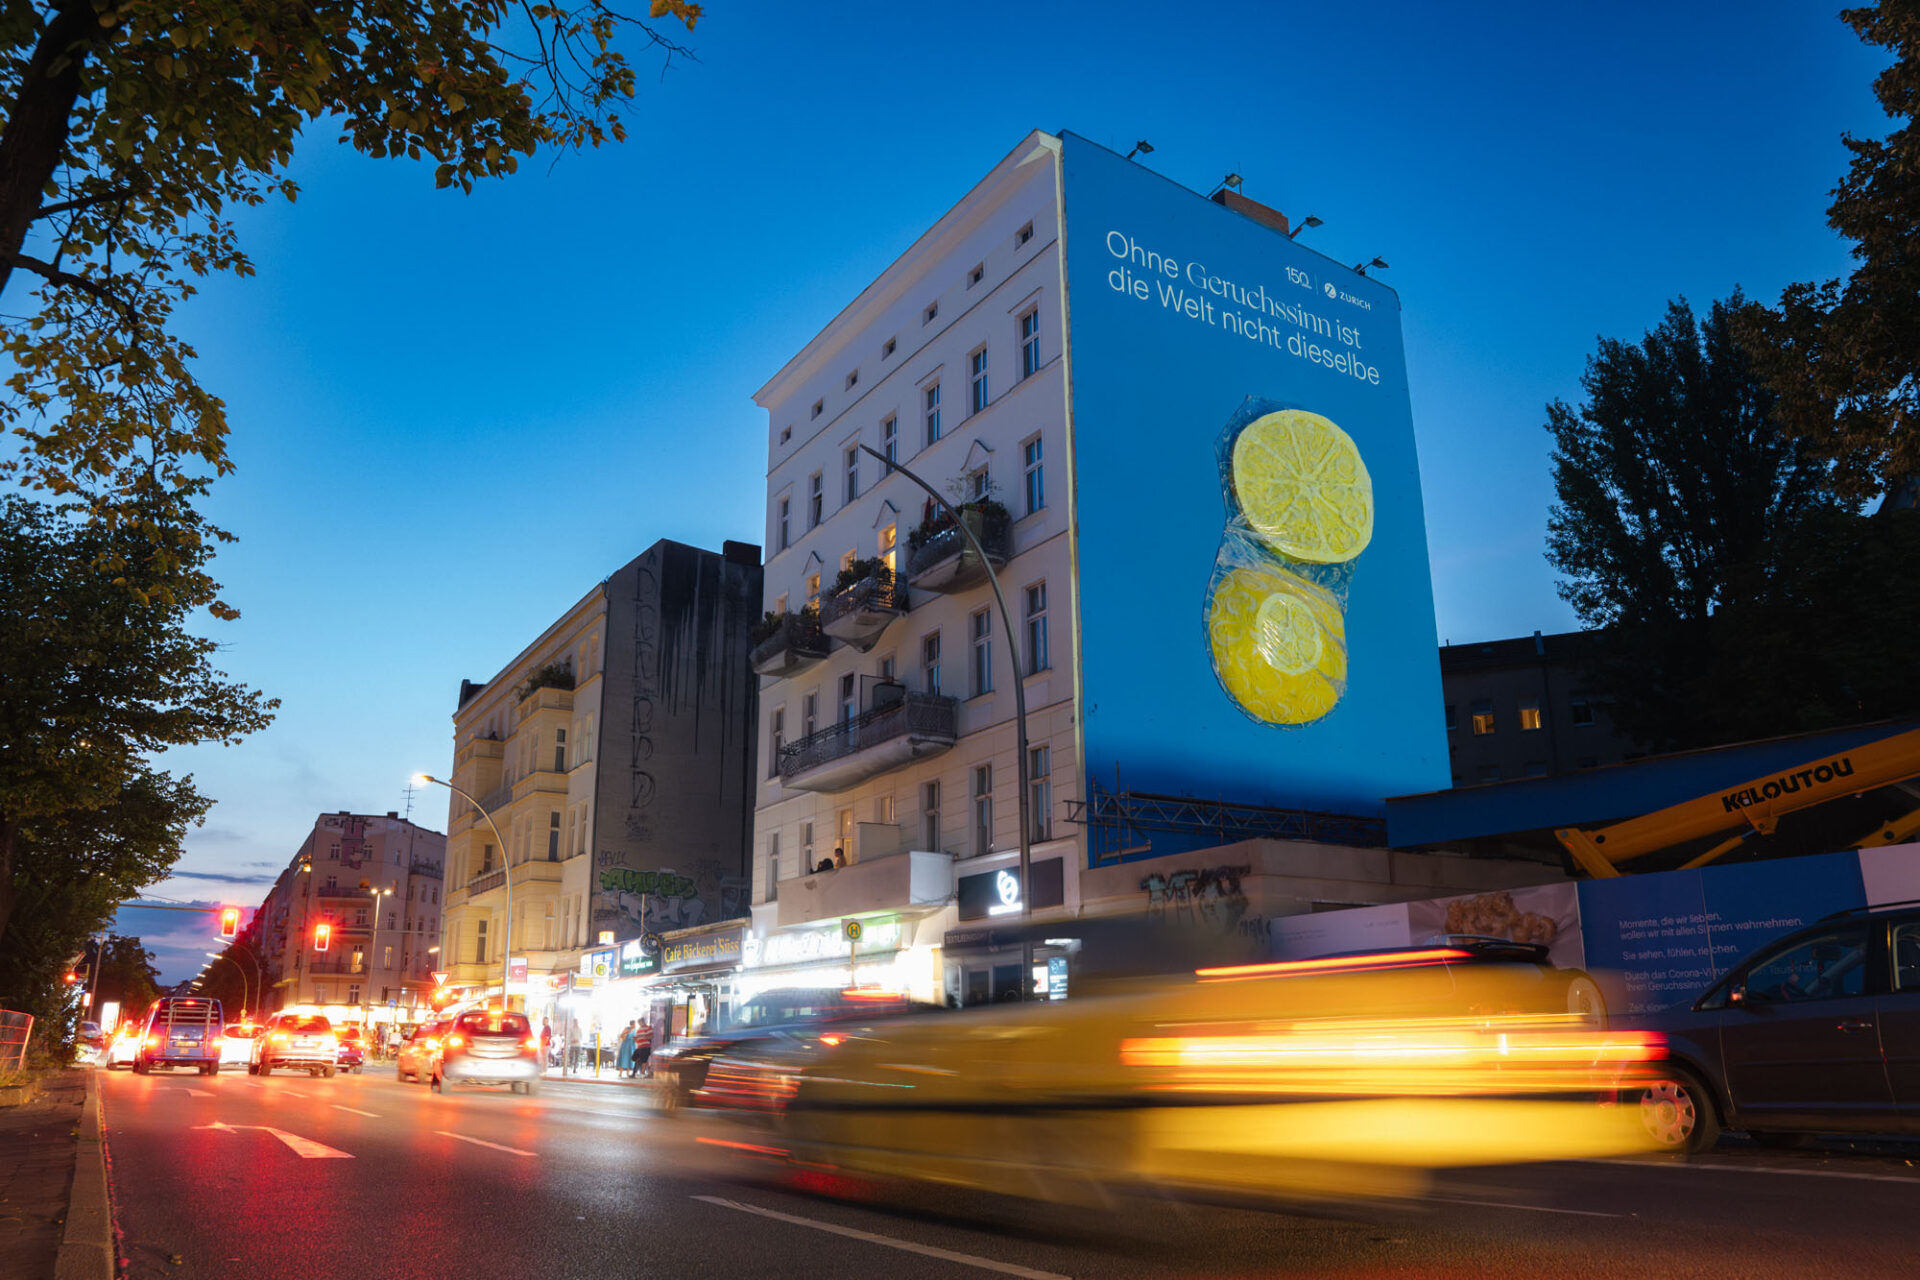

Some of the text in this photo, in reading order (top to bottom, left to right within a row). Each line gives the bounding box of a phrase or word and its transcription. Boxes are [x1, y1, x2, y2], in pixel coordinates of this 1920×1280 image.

[1106, 230, 1362, 349] Ohne Geruchssinn ist
[1340, 291, 1371, 311] ZURICH
[1108, 266, 1380, 385] die Welt nicht dieselbe
[1619, 919, 1660, 930] Momente,
[1661, 917, 1674, 926] die
[1676, 916, 1688, 925] wir
[1620, 930, 1646, 940] wollen
[1647, 929, 1659, 938] wir
[1661, 927, 1675, 936] mit
[1676, 926, 1696, 935] allen
[1735, 917, 1803, 930] wahrnehmen.
[664, 944, 681, 963] Café
[683, 939, 717, 960] Bäckerei
[1623, 951, 1636, 960] Sie
[1638, 949, 1666, 960] sehen,
[1624, 970, 1650, 981] Durch
[1652, 969, 1666, 979] das
[1649, 980, 1701, 992] Geruchssinn
